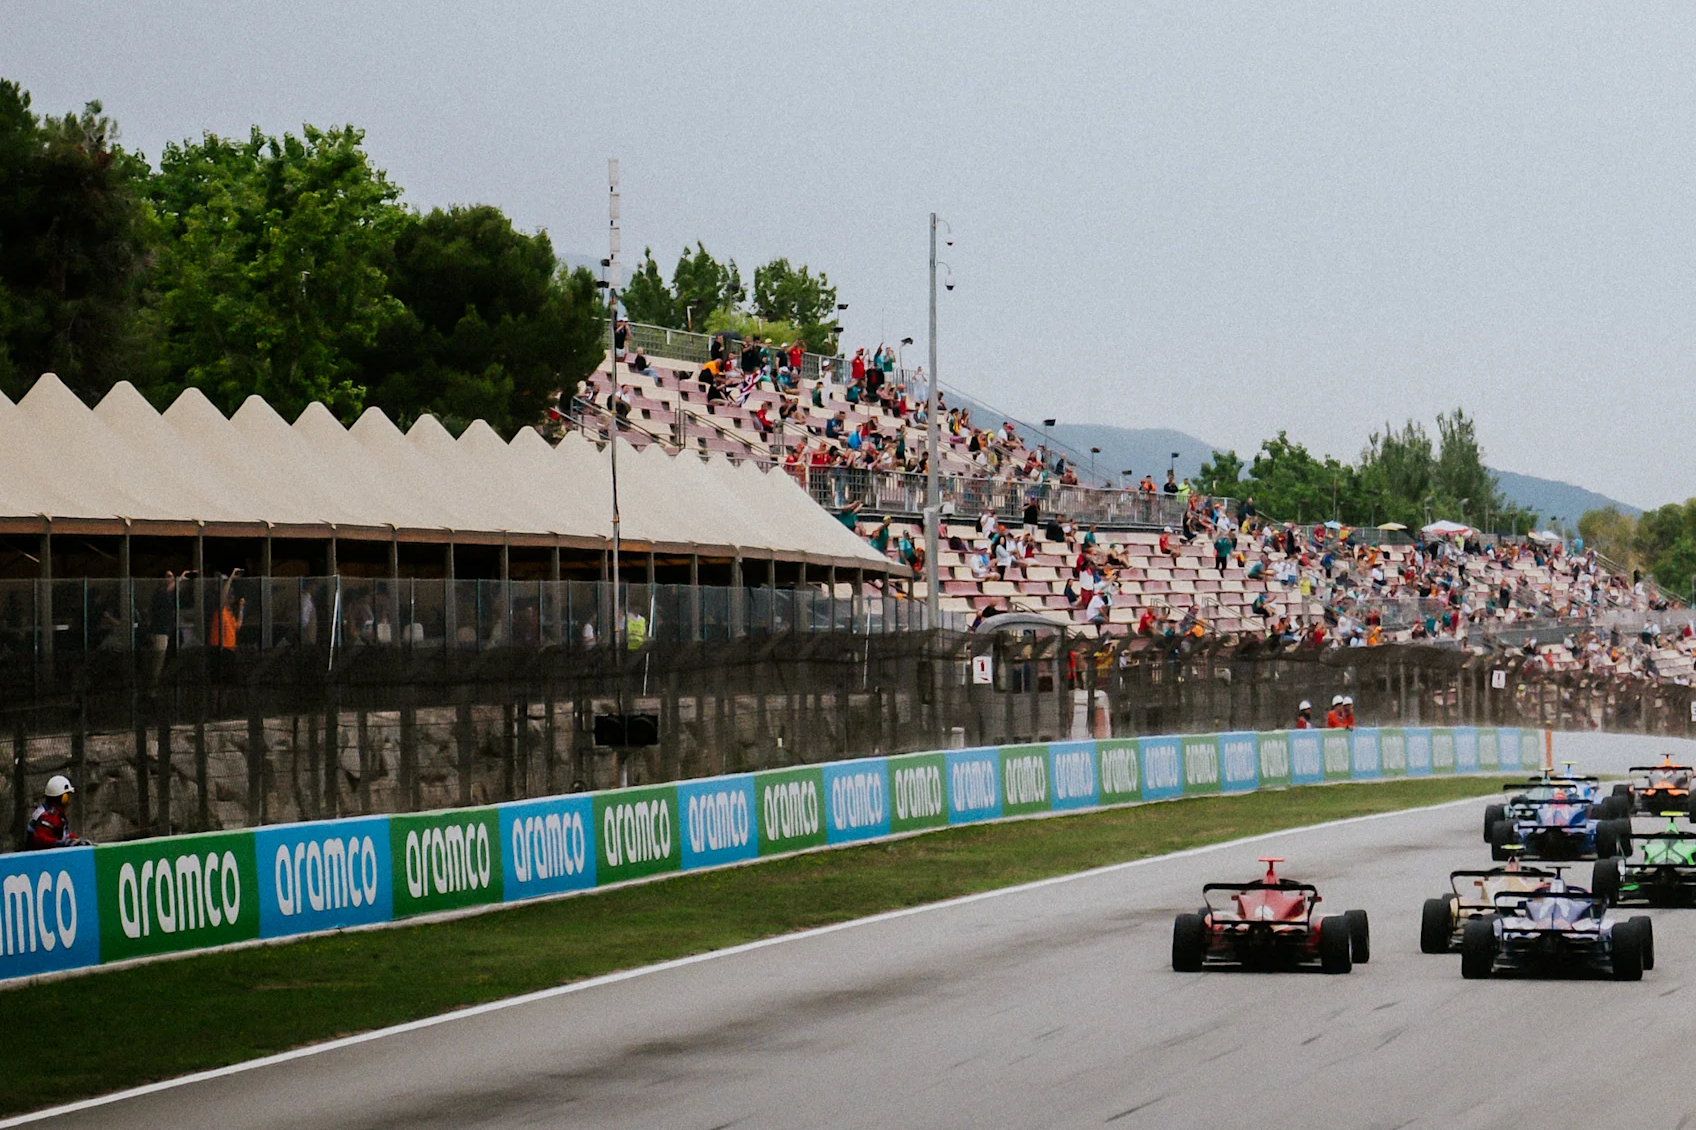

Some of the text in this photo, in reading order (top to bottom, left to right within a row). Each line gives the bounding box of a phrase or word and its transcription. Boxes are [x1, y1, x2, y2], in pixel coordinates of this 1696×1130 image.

[118, 850, 241, 939] aramco
[275, 835, 378, 916] aramco
[405, 822, 491, 899] aramco
[512, 811, 585, 882] aramco
[604, 798, 671, 867] aramco
[688, 789, 749, 853] aramco
[764, 780, 818, 841] aramco
[832, 772, 883, 830] aramco
[895, 765, 941, 820] aramco
[952, 760, 996, 812] aramco
[1005, 756, 1046, 805] aramco
